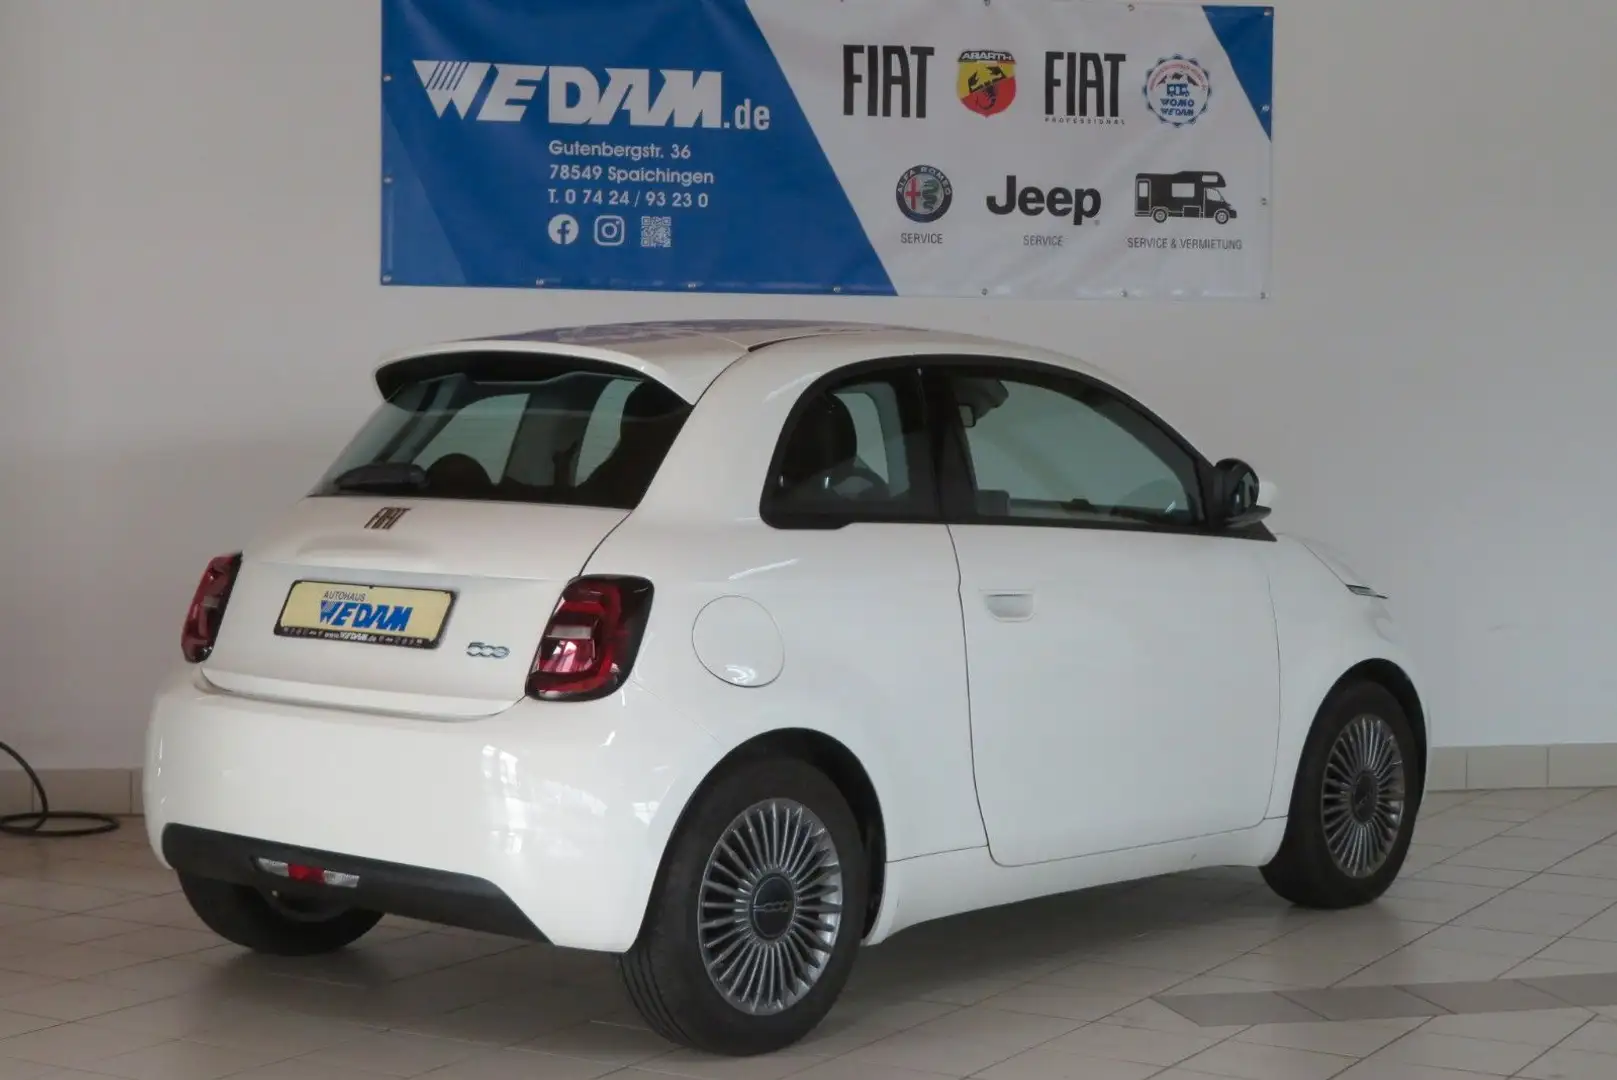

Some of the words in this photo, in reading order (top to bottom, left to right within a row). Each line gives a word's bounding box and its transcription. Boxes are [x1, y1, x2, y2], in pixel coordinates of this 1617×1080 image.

[961, 51, 1012, 61] ABARTH
[843, 44, 934, 119] FIAT
[1043, 51, 1126, 118] FIAT
[1044, 116, 1126, 125] PROFESSIONAL
[548, 139, 664, 161] Gutenbergstr.
[670, 143, 692, 160] 36
[549, 164, 603, 181] 78549
[607, 165, 714, 188] Spaichingen
[897, 169, 916, 194] ALFA
[920, 166, 952, 196] ROMEO
[547, 188, 559, 205] T.
[565, 189, 577, 205] 0
[582, 190, 603, 205] 74
[608, 190, 630, 206] 24
[645, 191, 666, 207] 93
[671, 192, 692, 208] 23
[697, 193, 709, 208] 0
[986, 175, 1101, 226] Jeep
[900, 232, 944, 244] SERVICE
[1023, 234, 1064, 247] SERVICE
[1127, 236, 1168, 249] SERVICE
[1170, 237, 1178, 249] &
[1179, 238, 1243, 251] VERMIETUNG
[364, 506, 411, 531] FIAT
[323, 590, 366, 601] AUTOHAUS
[319, 600, 414, 632] WEDAM
[466, 641, 511, 660] 500
